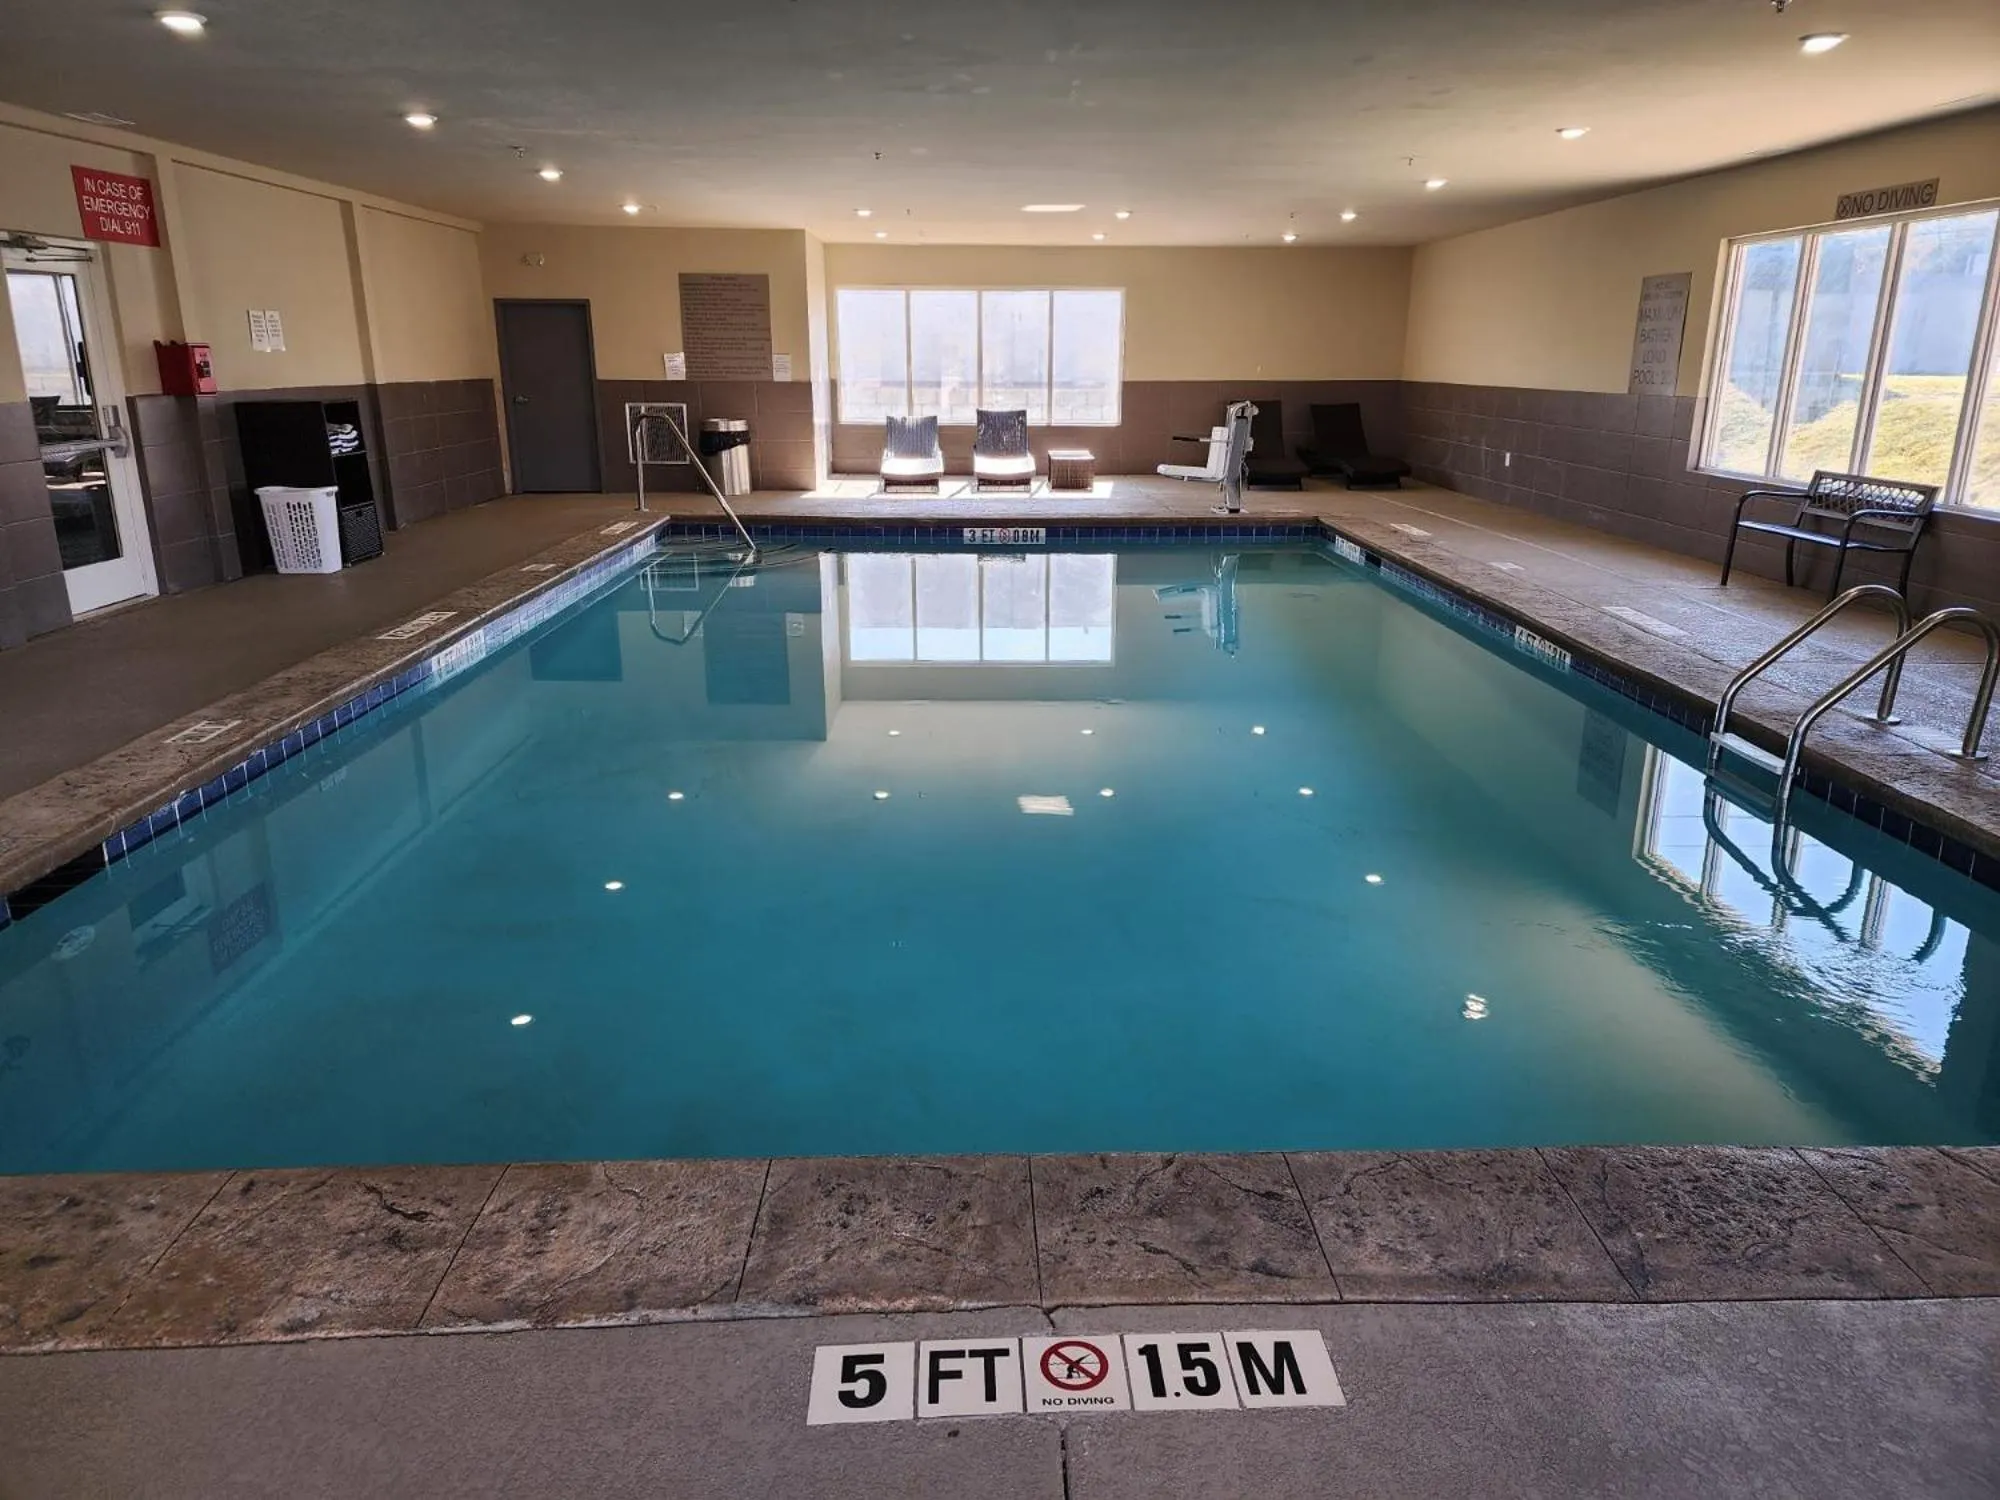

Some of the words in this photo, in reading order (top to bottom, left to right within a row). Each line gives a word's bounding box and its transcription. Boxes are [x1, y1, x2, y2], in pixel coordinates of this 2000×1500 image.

[83, 176, 96, 193] IN
[97, 179, 127, 199] CASE
[128, 185, 144, 200] OF
[1851, 193, 1874, 214] NO
[1877, 184, 1934, 210] DIVING
[82, 195, 150, 219] EMERGENCY
[99, 216, 124, 234] DIAL
[125, 220, 141, 236] 911
[968, 529, 977, 543] 3
[838, 1353, 887, 1408] 5
[928, 1348, 1010, 1404] FT
[1137, 1343, 1221, 1398] 1.5
[1236, 1341, 1307, 1395] M
[1042, 1397, 1063, 1406] NO
[1067, 1396, 1115, 1405] DIVING
